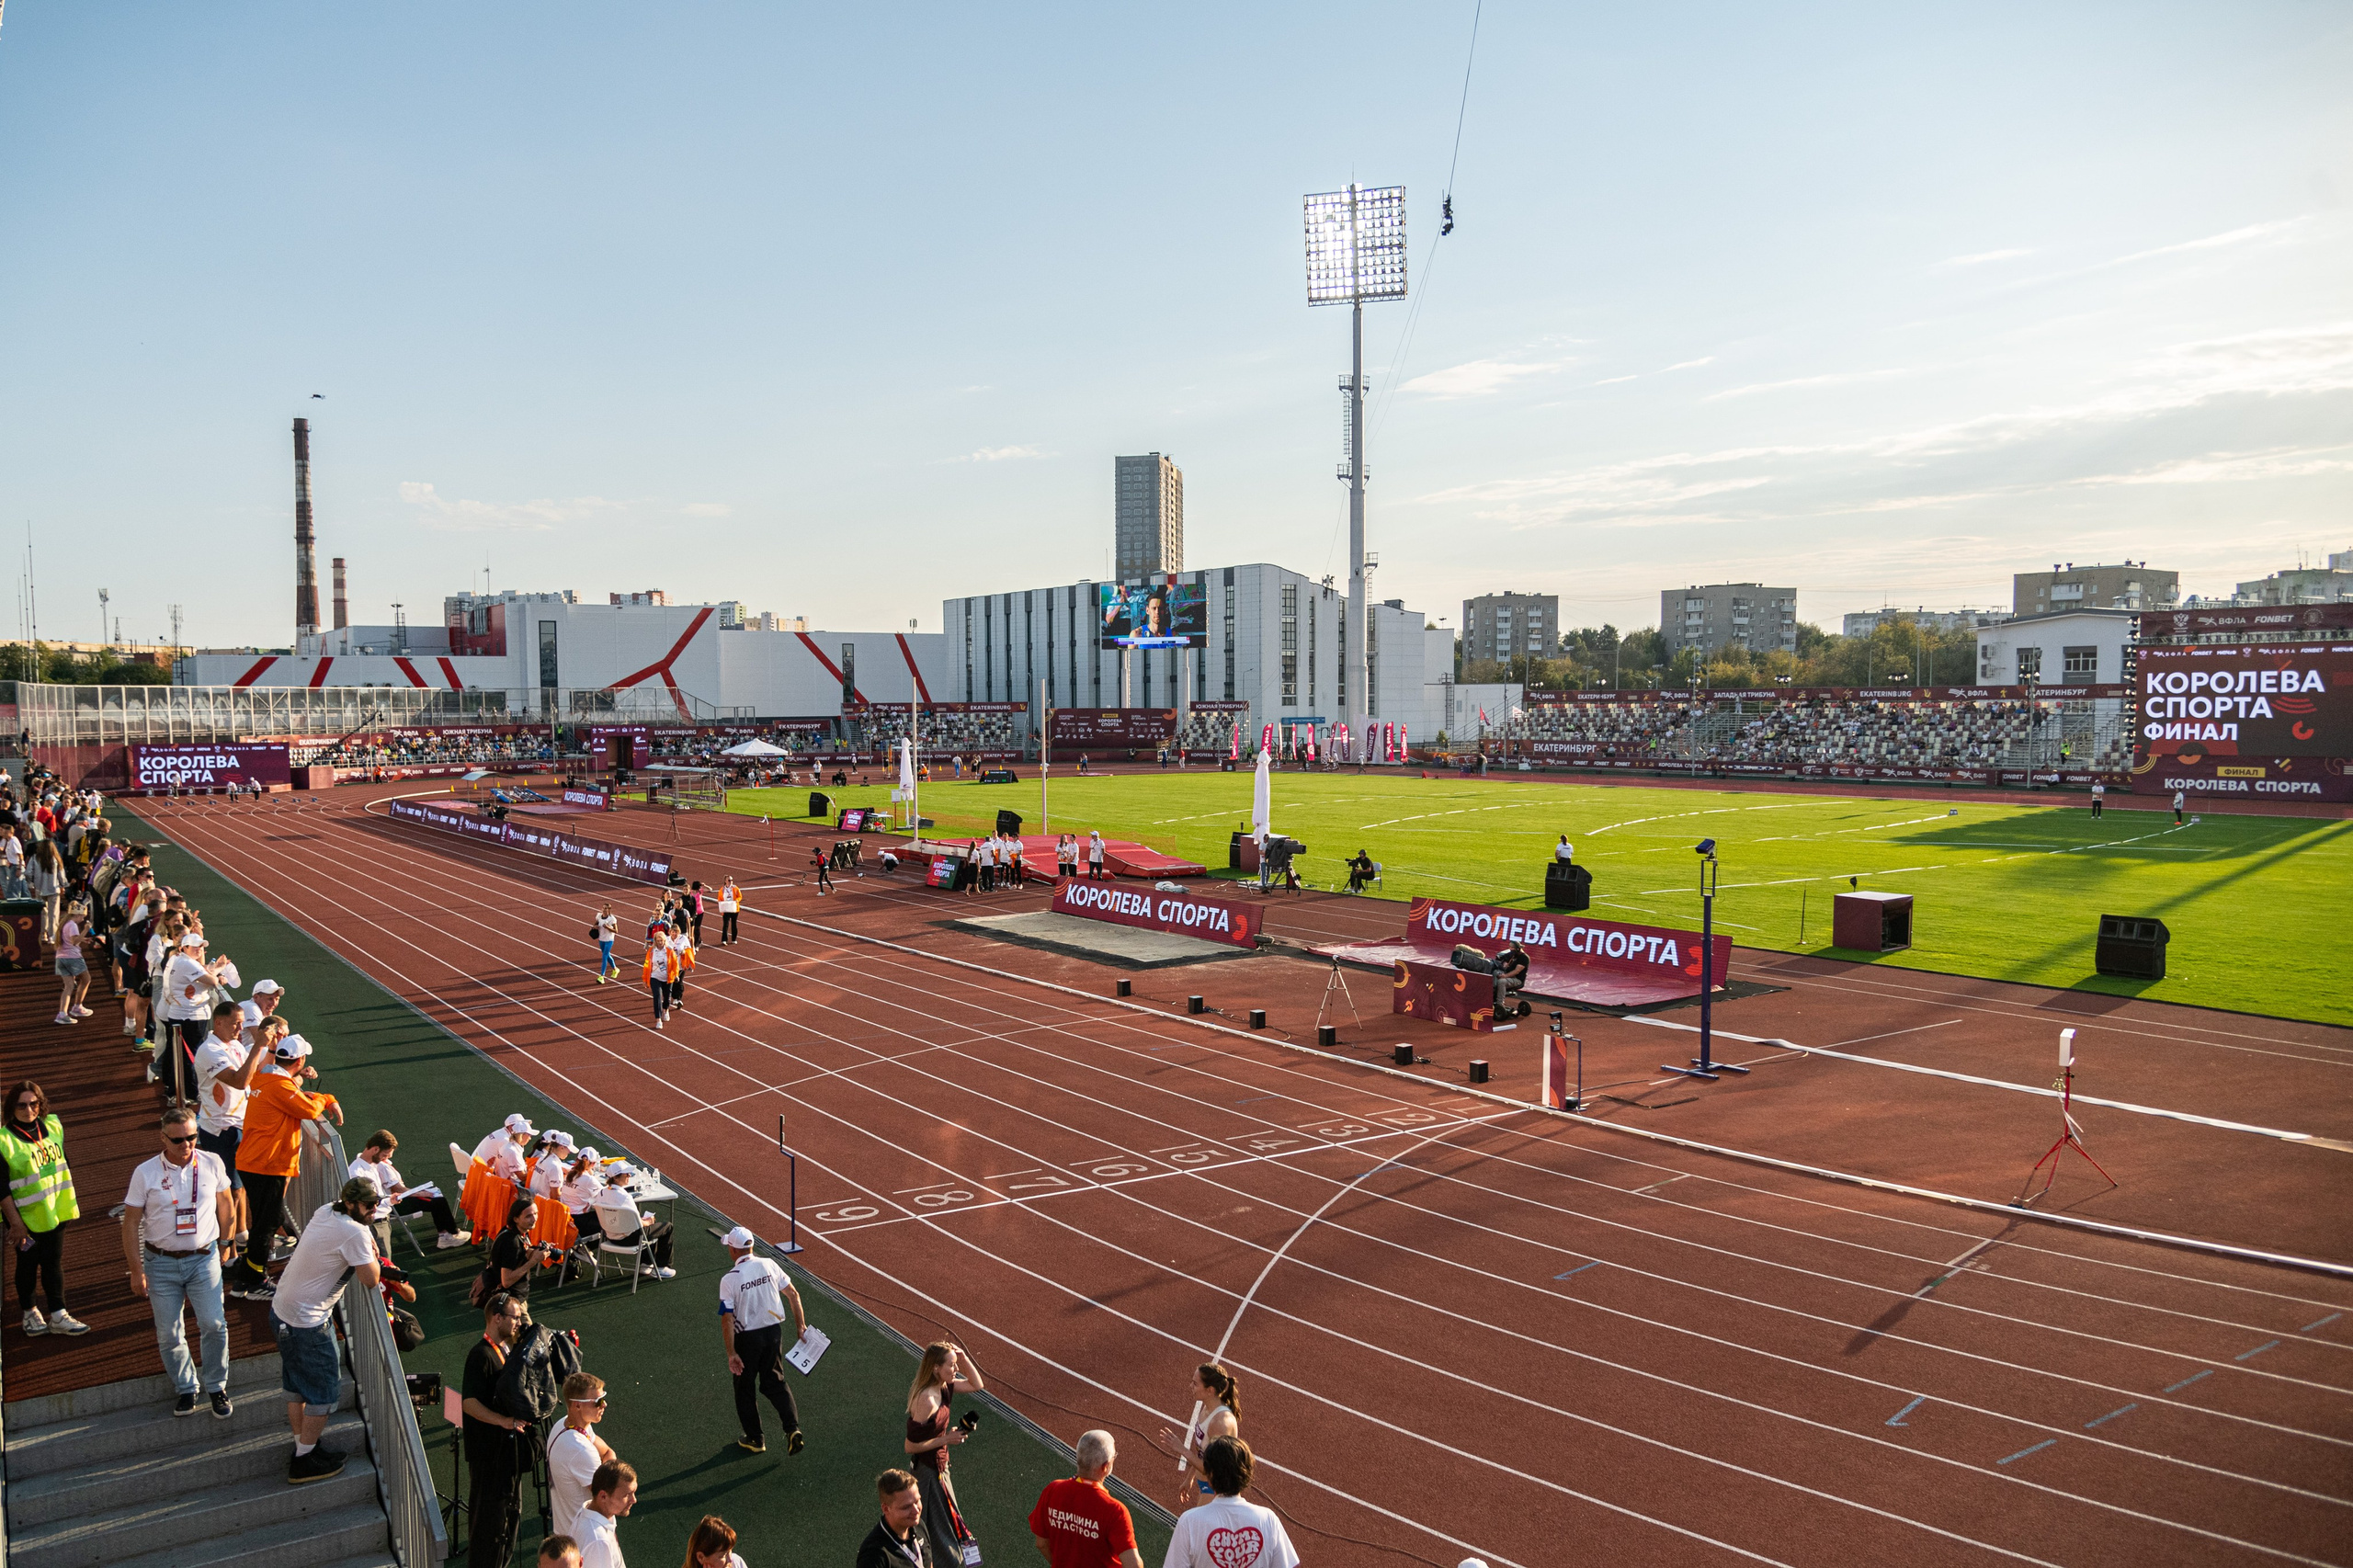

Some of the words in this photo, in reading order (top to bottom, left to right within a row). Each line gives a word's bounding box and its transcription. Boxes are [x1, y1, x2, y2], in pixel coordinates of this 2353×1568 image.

[2255, 614, 2294, 623] FONBET
[2147, 670, 2325, 693] КОРОЛЕВА
[2145, 696, 2273, 718] СПОРТА
[2143, 722, 2238, 740] ФИНАЛ
[1534, 743, 1597, 753] ЕКАТЕРИНБУРГ
[140, 755, 240, 770] КОРОЛЕВА
[2165, 778, 2249, 791] КОРОЛЕВА
[2255, 781, 2322, 794] СПОРТА
[564, 791, 585, 803] КОРОЛЕВА
[586, 794, 603, 806] СПОРТА
[650, 862, 668, 874] FONBET
[933, 862, 955, 871] КОРОЛЕВА
[1065, 884, 1152, 918] КОРОЛЕВА
[1158, 899, 1229, 932] СПОРТА
[1426, 907, 1557, 948] КОРОЛЕВА
[1567, 926, 1680, 966] СПОРТА
[1384, 1110, 1436, 1126] 2
[1317, 1123, 1370, 1140] 3
[1248, 1137, 1298, 1153] 4
[1170, 1150, 1230, 1165] 5
[1091, 1162, 1149, 1179] 6
[1009, 1175, 1070, 1191] 7
[913, 1188, 977, 1208] 8
[814, 1205, 880, 1225] 9
[741, 1275, 772, 1292] FONBET
[801, 1358, 810, 1368] 5
[1210, 1530, 1261, 1547] RHYME
[1210, 1540, 1259, 1560] YOUR
